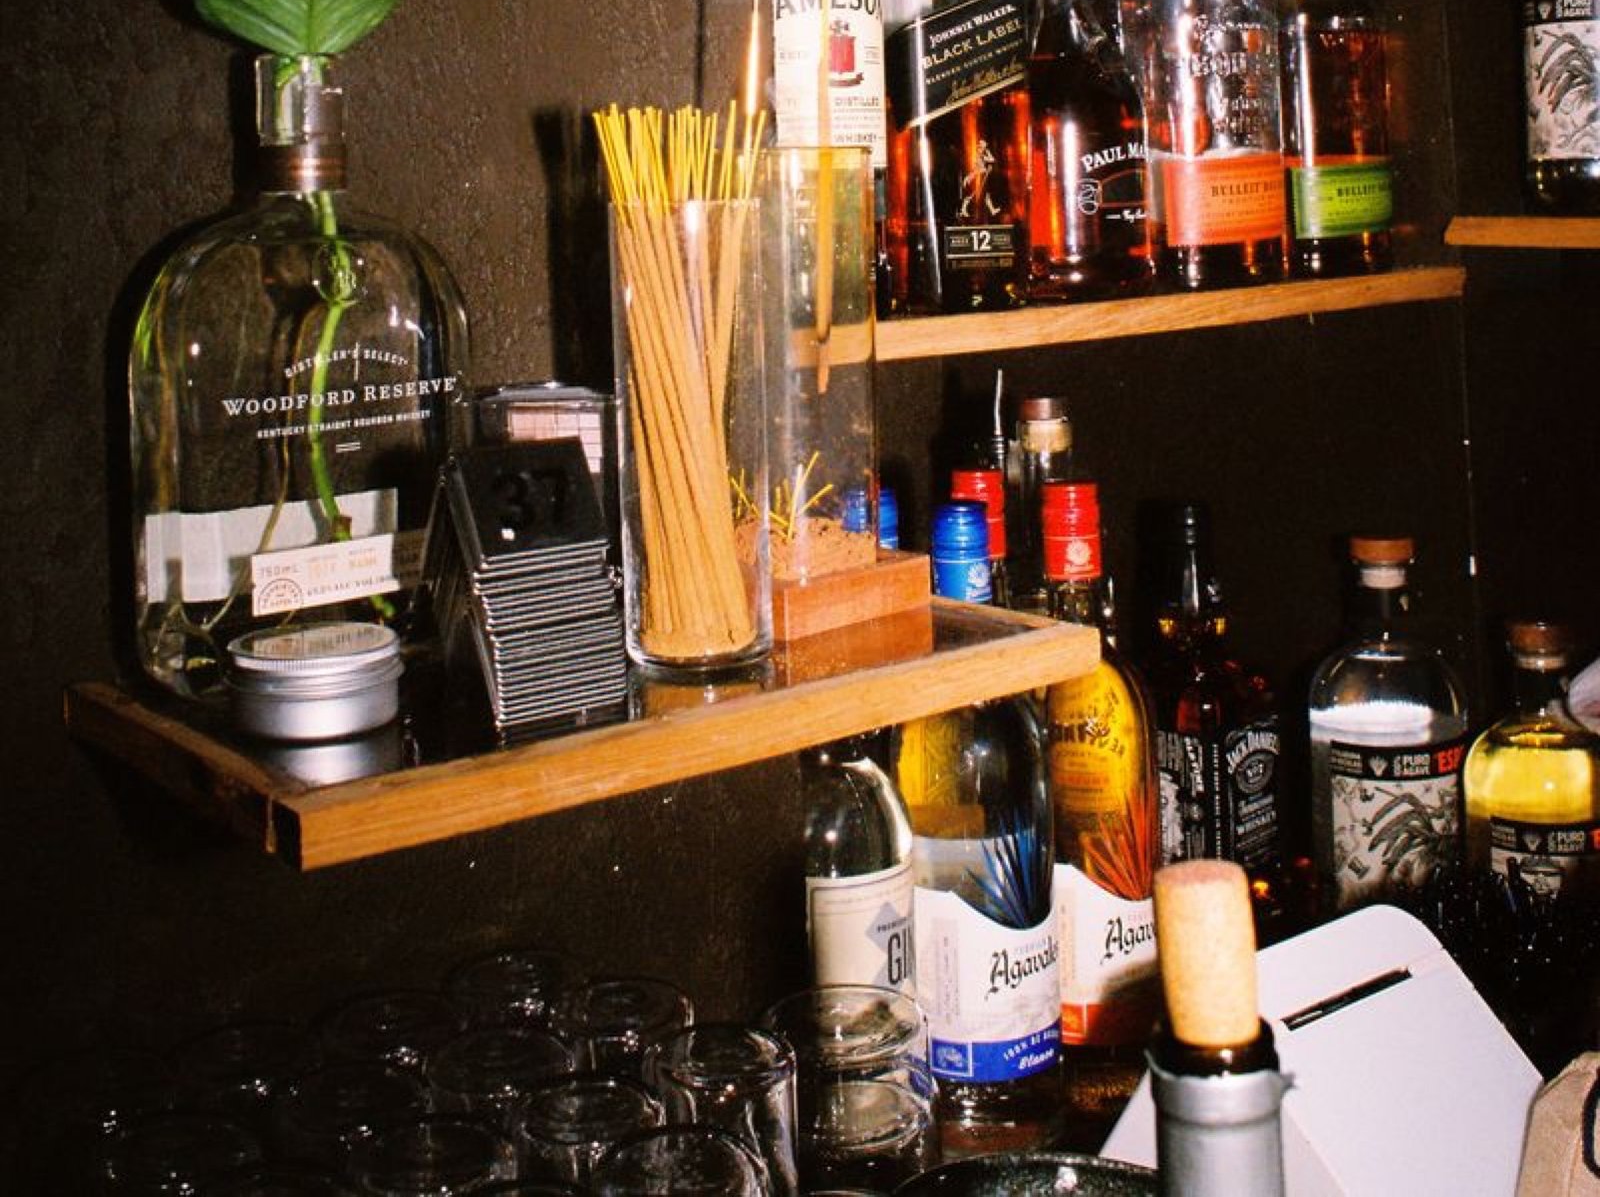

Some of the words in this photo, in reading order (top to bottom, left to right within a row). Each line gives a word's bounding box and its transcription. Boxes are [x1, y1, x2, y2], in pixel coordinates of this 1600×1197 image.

[929, 21, 973, 49] JOHNNIE
[972, 4, 1017, 25] WALKER
[922, 38, 973, 69] BLACK
[975, 18, 1022, 45] LABEL
[1080, 146, 1126, 173] PAUL
[971, 230, 992, 252] 12
[222, 389, 356, 416] WOODFORD
[363, 376, 455, 402] RESERVE
[257, 425, 305, 439] KENTUCKY
[354, 414, 393, 428] BOURBON
[1226, 740, 1248, 774] JACK
[1403, 754, 1431, 765] PURO
[1403, 765, 1431, 775] AGAVE
[1100, 916, 1156, 965] Agav
